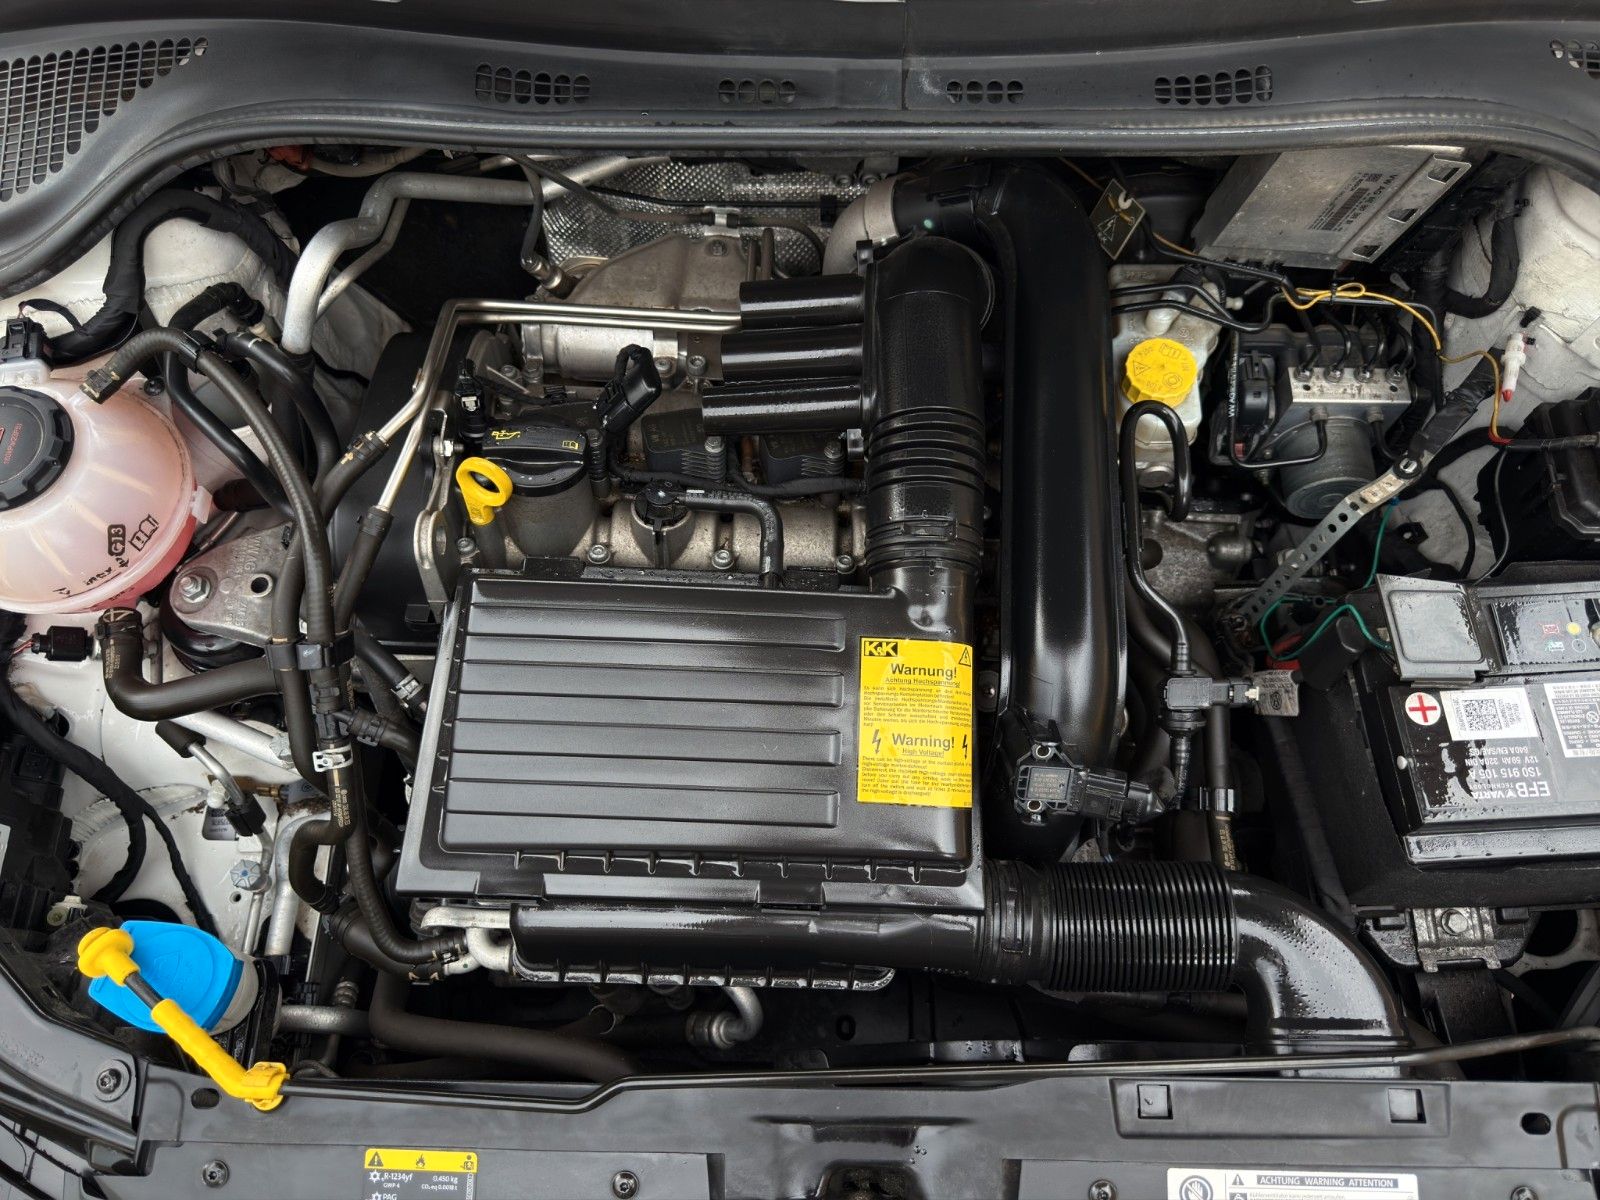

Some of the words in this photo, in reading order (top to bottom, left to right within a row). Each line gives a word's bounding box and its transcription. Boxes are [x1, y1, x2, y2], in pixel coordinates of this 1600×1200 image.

[864, 641, 898, 656] K&K
[891, 663, 957, 680] Warnung!
[892, 732, 955, 751] Warning!
[1468, 769, 1476, 779] A
[1478, 768, 1498, 778] 105
[1500, 767, 1520, 778] 915
[1470, 790, 1505, 799] VARTA
[1516, 781, 1550, 797] EFB
[450, 1176, 458, 1184] kg
[1260, 1176, 1300, 1186] ACHTUNG
[1304, 1177, 1344, 1186] WARNING
[1348, 1178, 1394, 1188] ATTENTION
